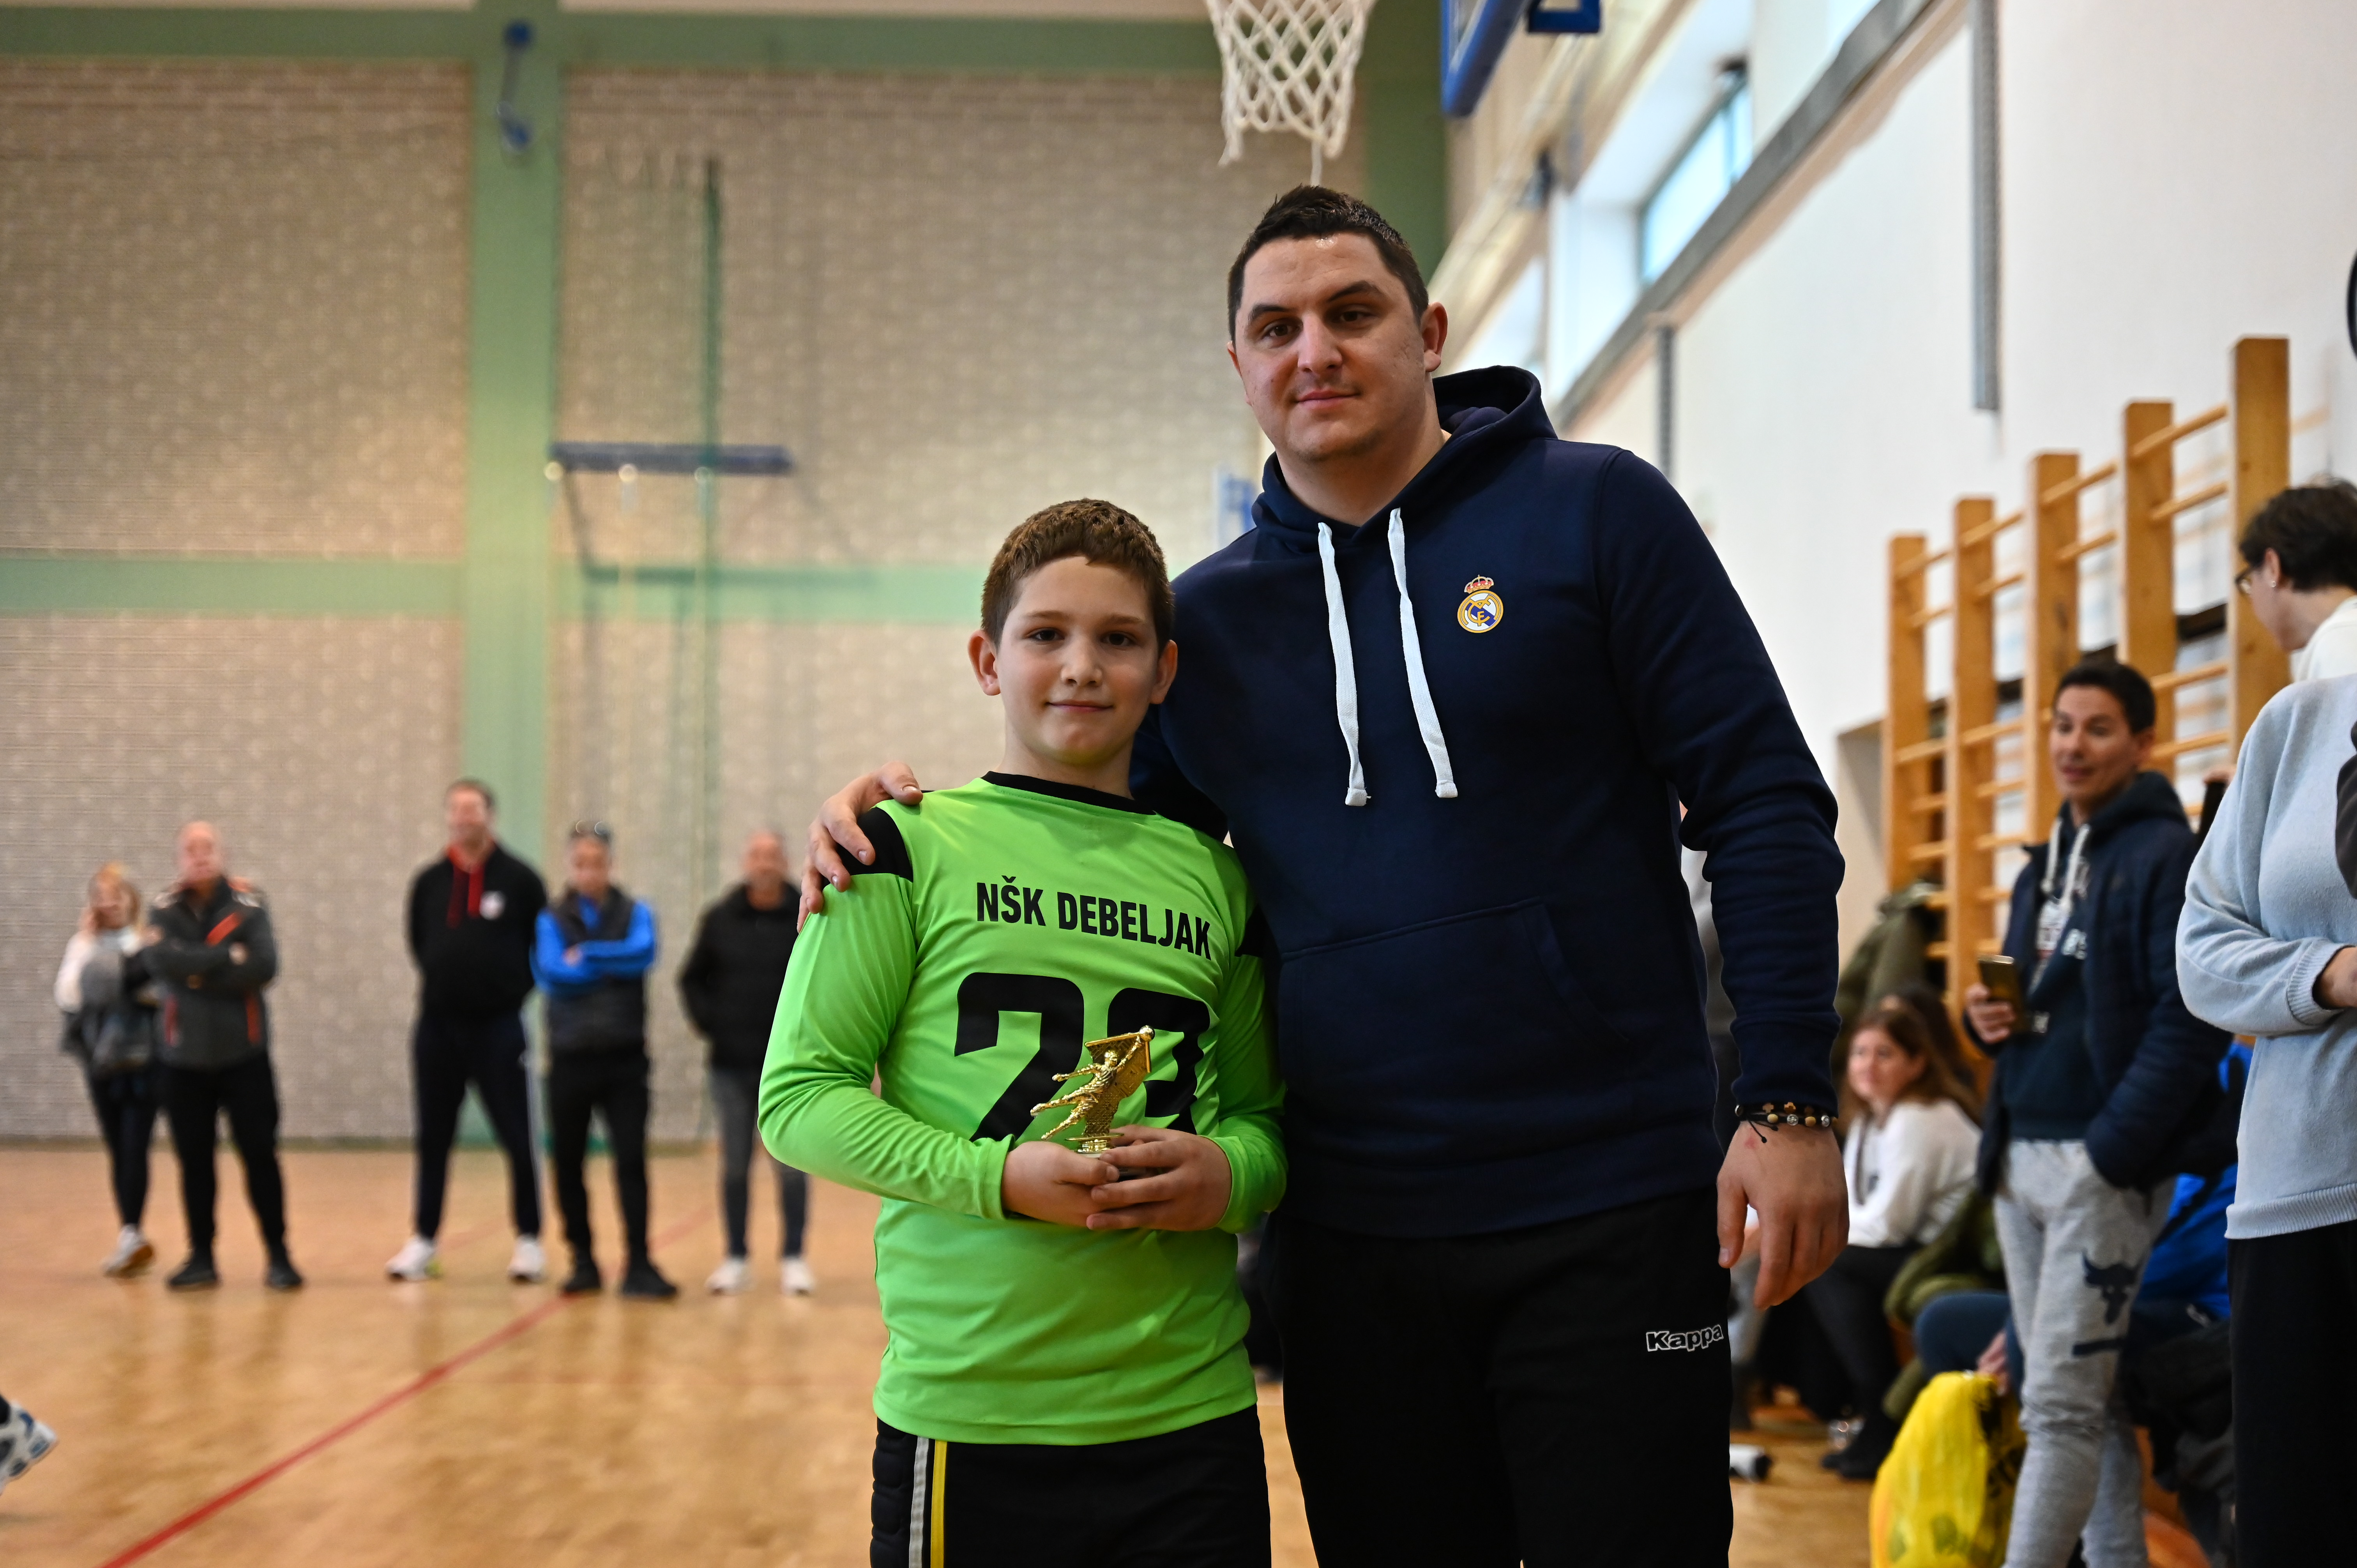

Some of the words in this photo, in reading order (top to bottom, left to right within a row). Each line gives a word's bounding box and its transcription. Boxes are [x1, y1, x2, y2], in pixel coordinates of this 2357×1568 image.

[976, 875, 1046, 927] NŠK
[1057, 892, 1212, 961] DEBELJAK
[1646, 1324, 1724, 1352] Kappa
